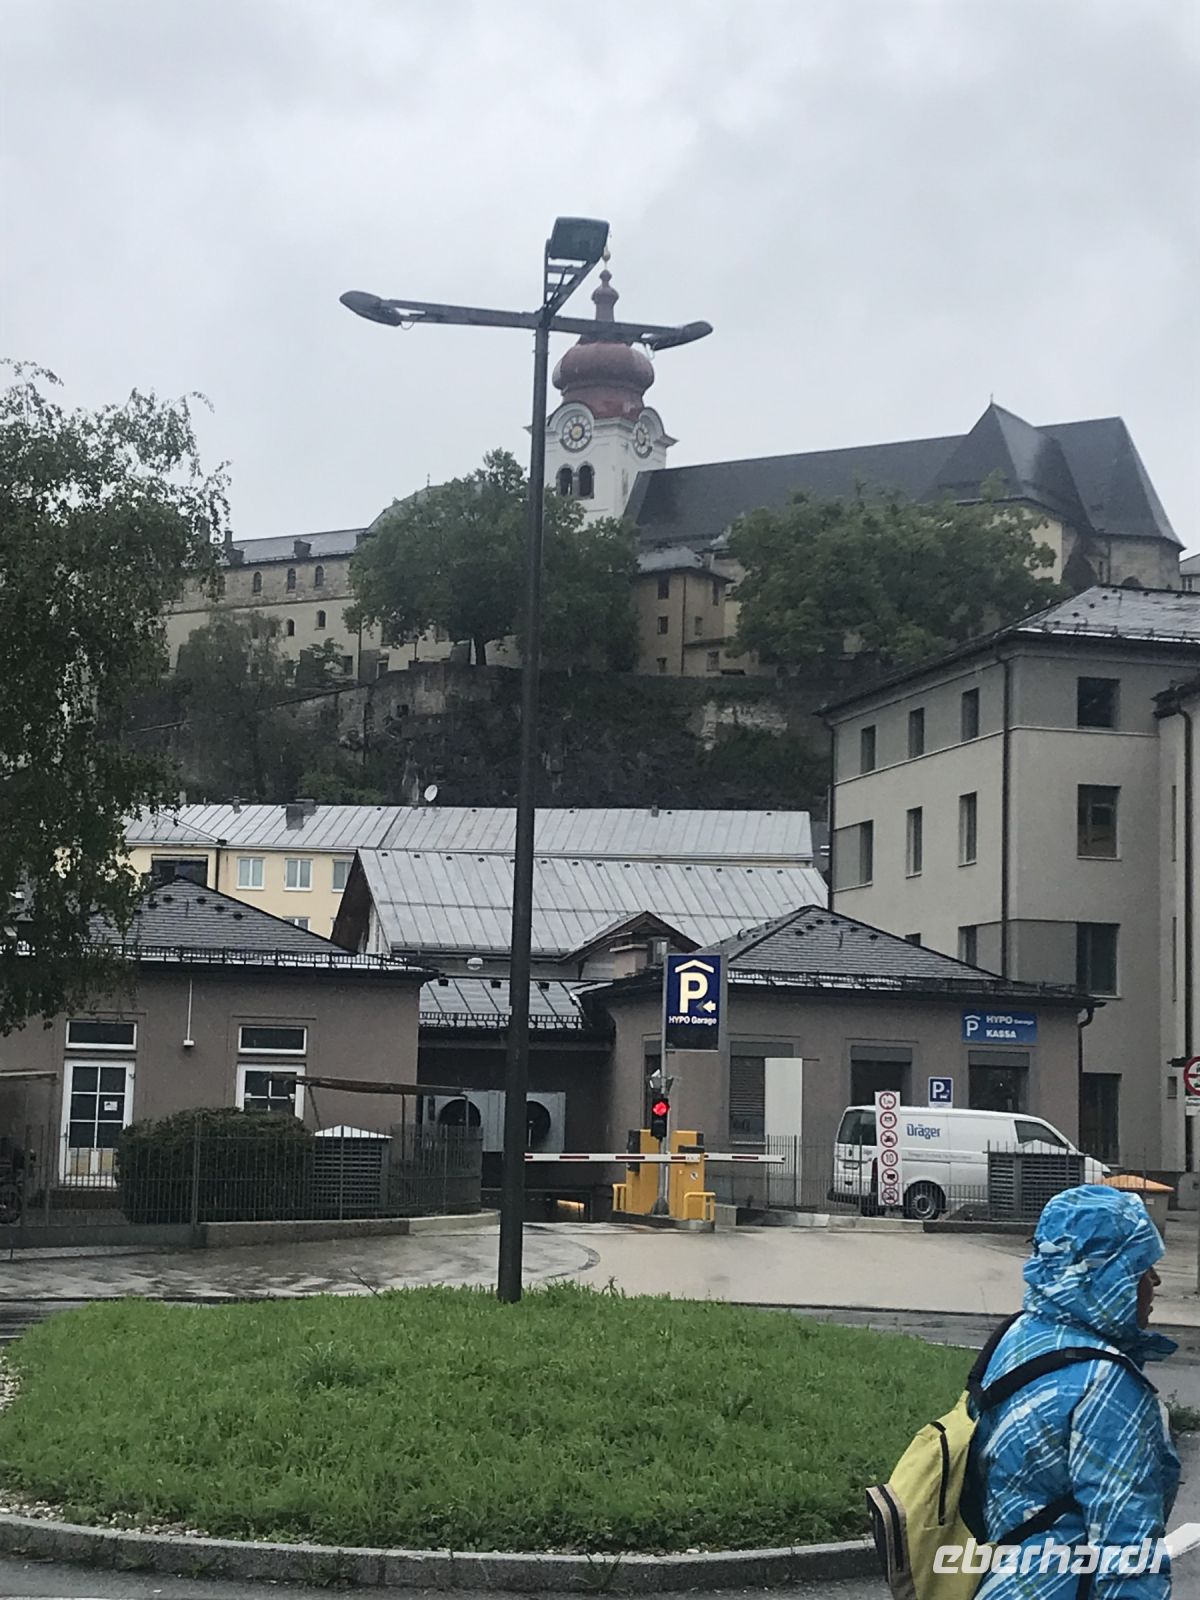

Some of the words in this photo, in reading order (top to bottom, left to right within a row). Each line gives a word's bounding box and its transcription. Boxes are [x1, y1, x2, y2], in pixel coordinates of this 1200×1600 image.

[680, 972, 708, 1013] P
[669, 1016, 690, 1024] HYPO
[691, 1015, 717, 1026] Garage
[986, 1015, 1013, 1024] HYPO
[966, 1020, 979, 1037] P
[986, 1029, 1017, 1038] KASSA
[932, 1081, 945, 1099] P
[906, 1123, 941, 1140] Dräger
